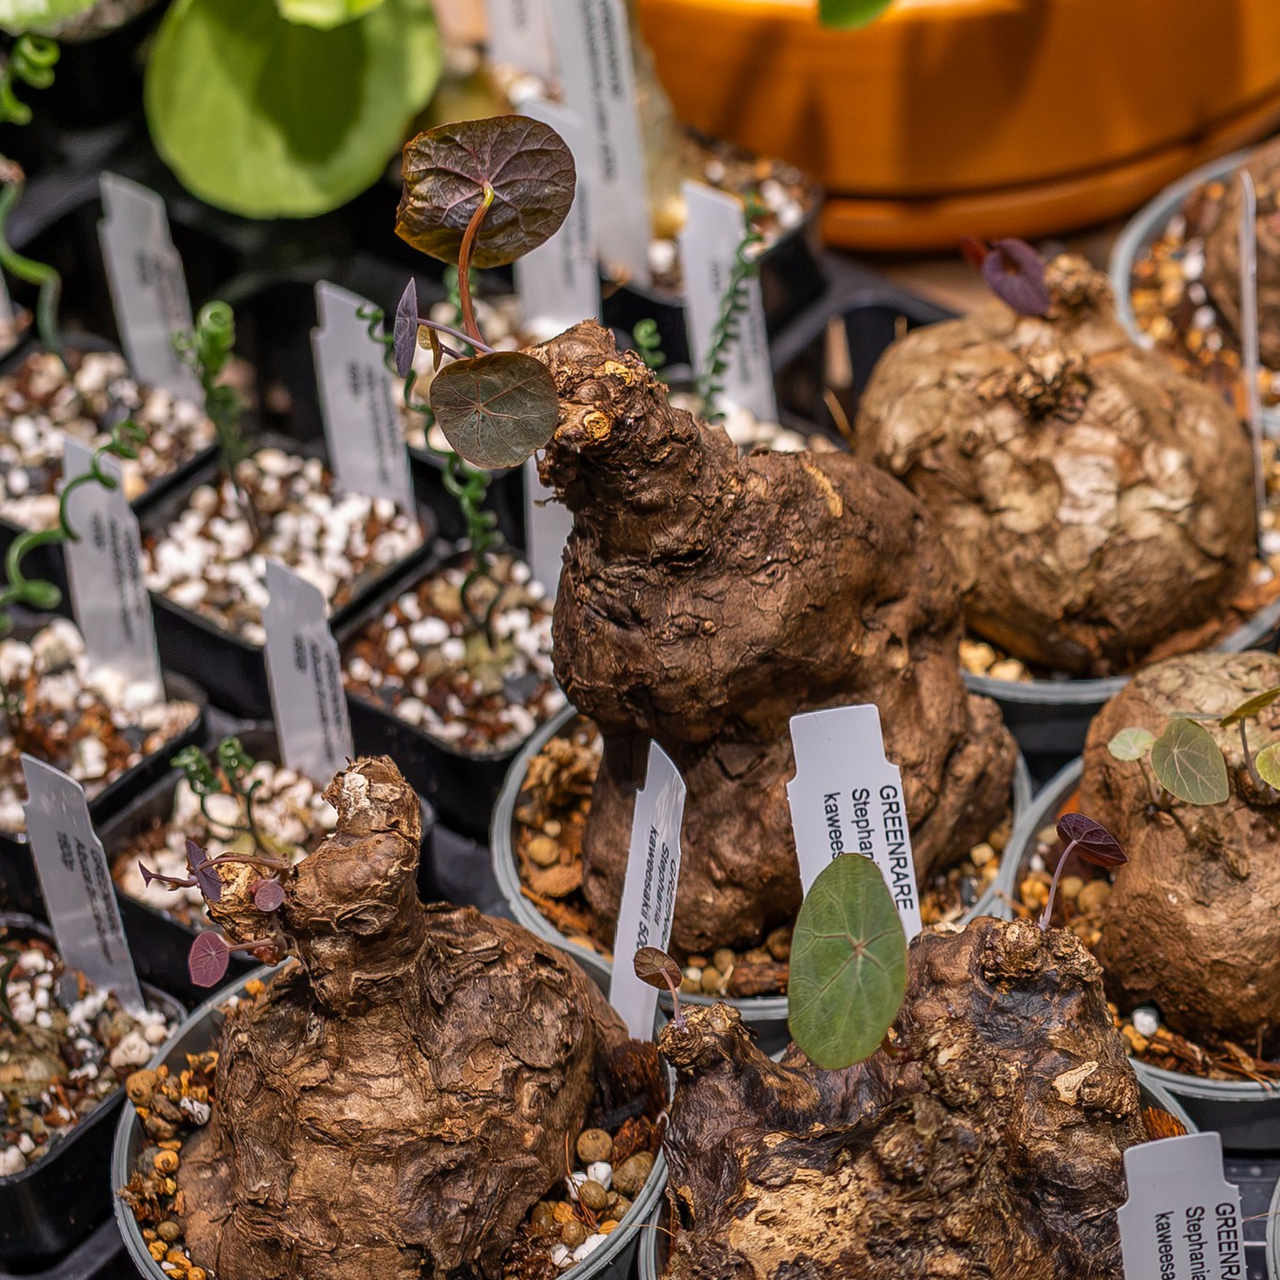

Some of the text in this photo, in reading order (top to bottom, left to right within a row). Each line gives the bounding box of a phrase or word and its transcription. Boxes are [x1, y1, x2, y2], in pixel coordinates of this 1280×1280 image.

[823, 791, 845, 860] kawees
[851, 787, 880, 865] Stephan
[879, 784, 914, 911] GREENRARE
